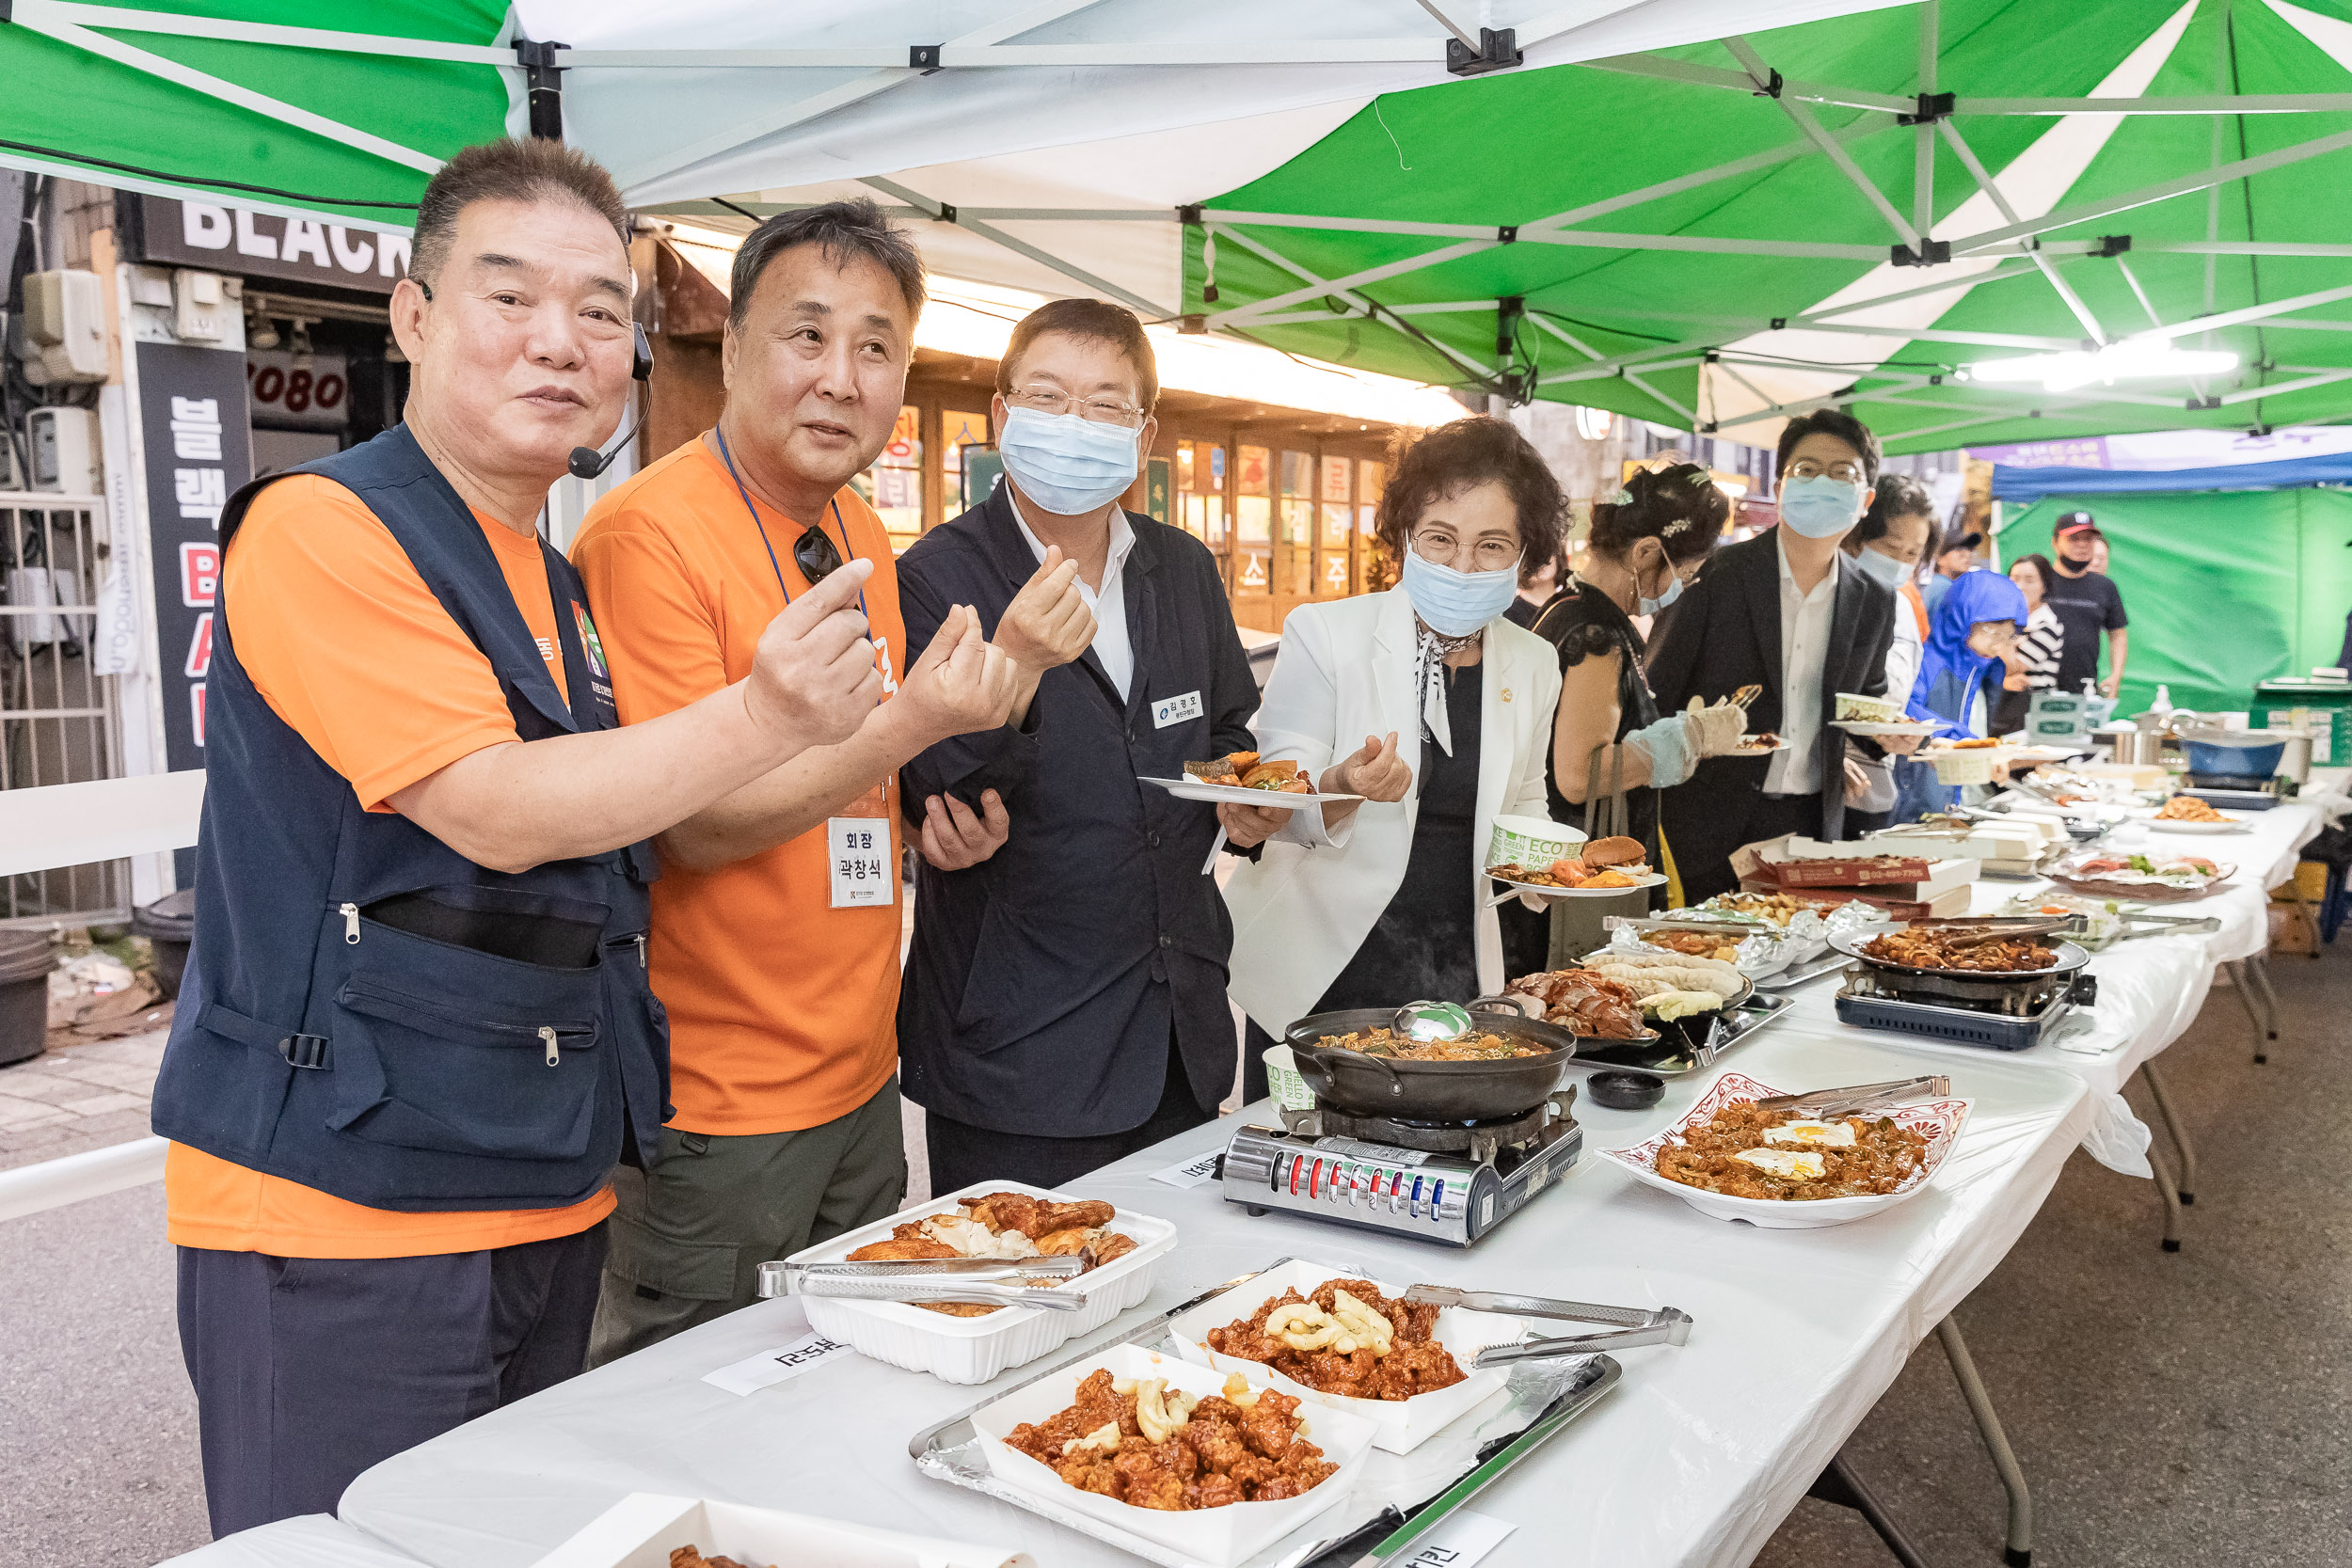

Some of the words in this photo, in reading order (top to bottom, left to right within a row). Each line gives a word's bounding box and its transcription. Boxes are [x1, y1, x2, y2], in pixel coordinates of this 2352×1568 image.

[247, 354, 342, 412] 080
[170, 396, 226, 531] 블랙
[846, 832, 873, 849] 회장
[1504, 838, 1525, 851] GREEN
[1530, 838, 1563, 855] ECO
[840, 859, 882, 880] 곽창석
[1284, 1070, 1295, 1099] GREEN
[1294, 1071, 1304, 1100] HELLO
